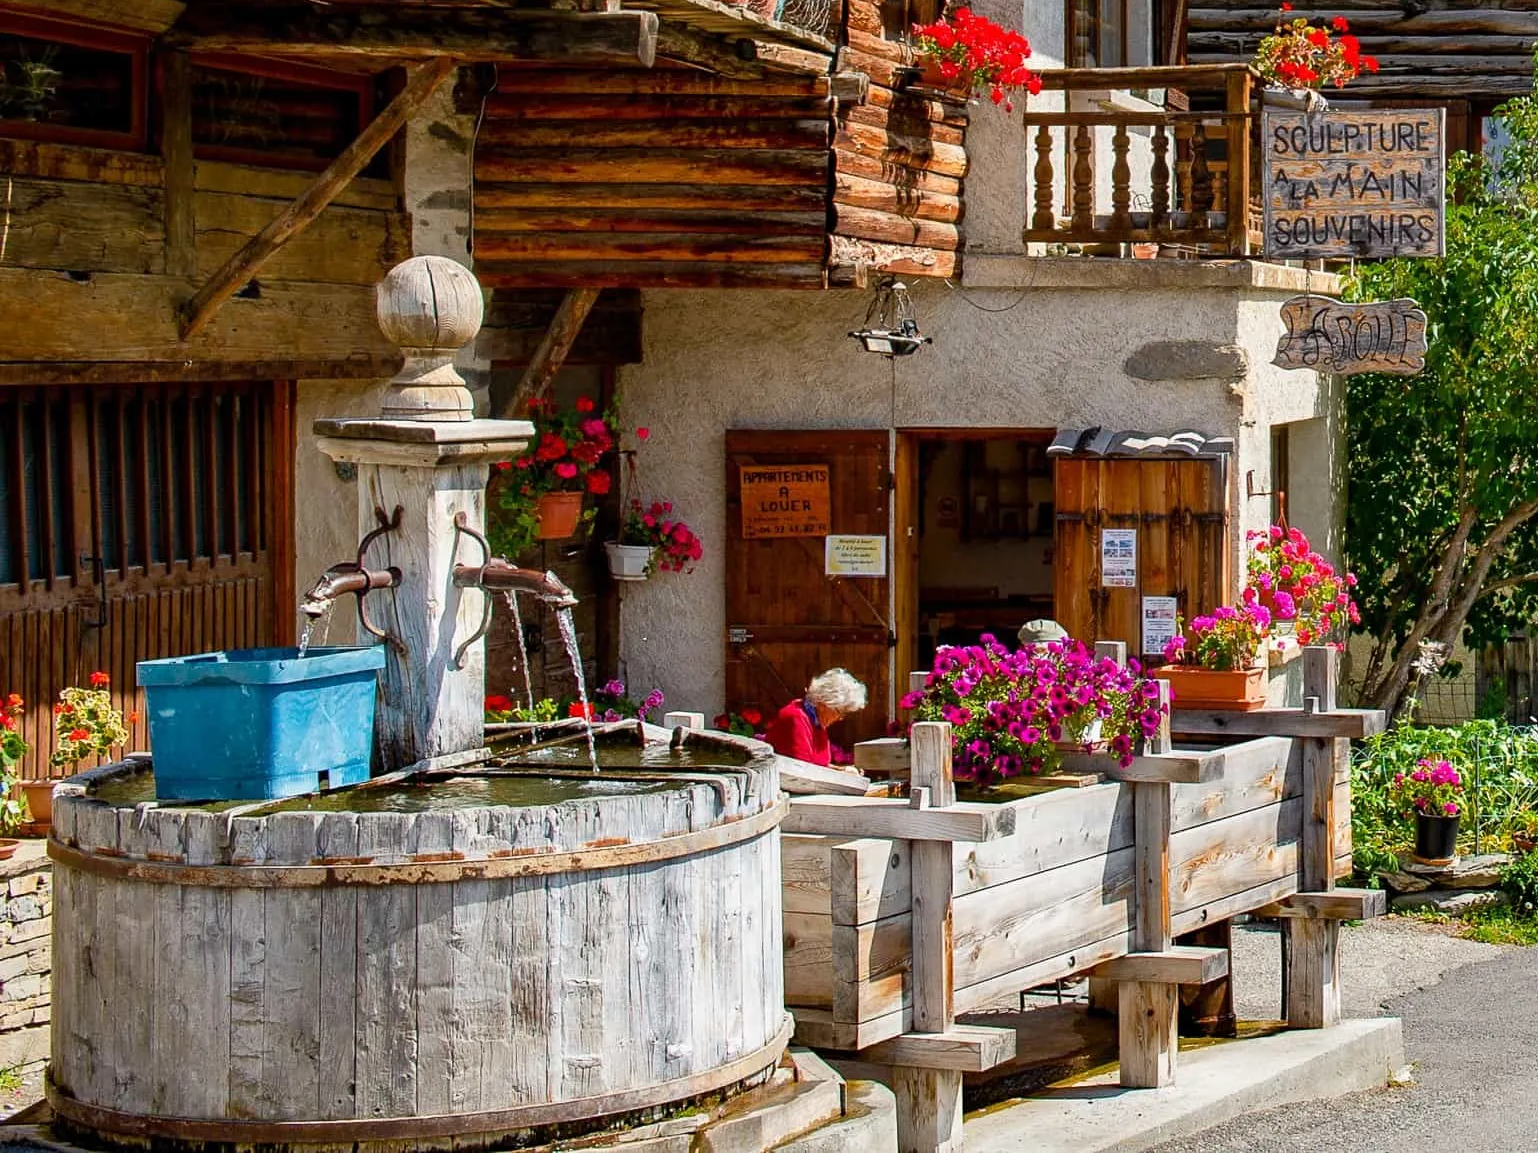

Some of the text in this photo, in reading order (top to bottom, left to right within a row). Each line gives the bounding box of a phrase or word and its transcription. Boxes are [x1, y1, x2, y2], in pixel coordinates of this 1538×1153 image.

[1273, 121, 1430, 154] SCULPTURE
[1290, 180, 1320, 200] LA
[1328, 167, 1422, 201] MAIN
[1273, 213, 1435, 246] SOUVENIRS
[743, 470, 827, 483] APPARTEMENTS
[761, 500, 811, 512] LOUER
